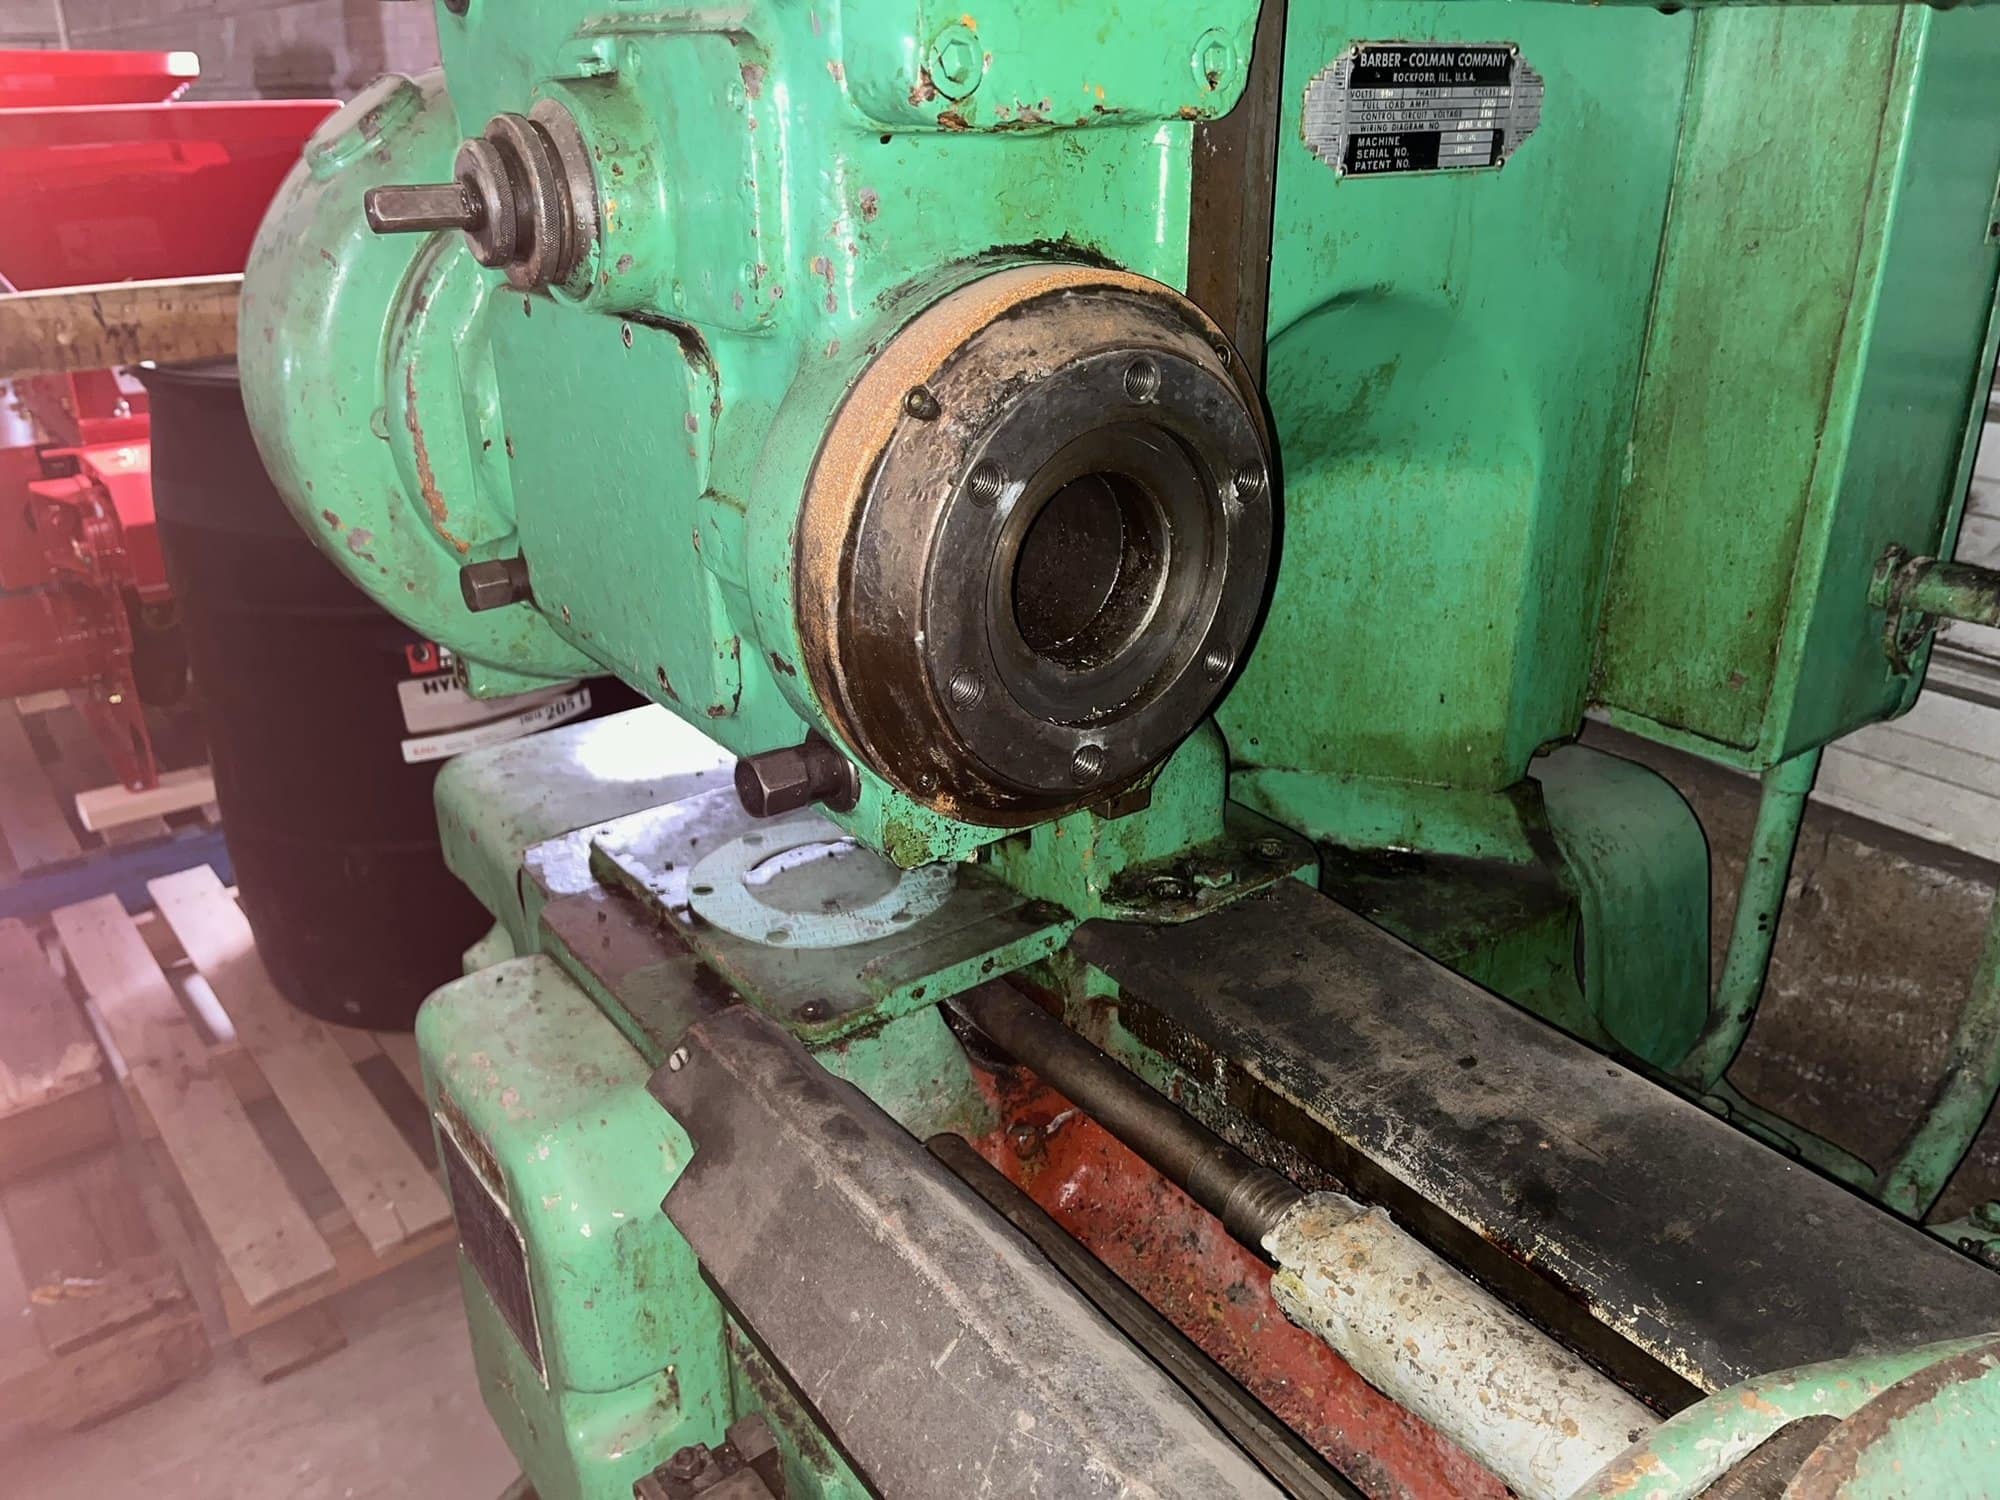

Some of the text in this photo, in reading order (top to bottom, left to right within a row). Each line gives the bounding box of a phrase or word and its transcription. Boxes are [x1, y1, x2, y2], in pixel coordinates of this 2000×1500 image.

[1457, 52, 1508, 67] COMPANY
[1350, 89, 1373, 98] VOLTS
[1415, 88, 1437, 97] PHASE
[1472, 87, 1497, 97] CYCLES
[1362, 101, 1380, 110] FULL
[1384, 101, 1406, 109] LOAD
[1360, 111, 1396, 121] CONTROL
[1400, 111, 1428, 120] CIRCUIT
[1432, 109, 1463, 118] VOLTAGE
[1360, 123, 1388, 132] WIRING
[1391, 122, 1425, 131] DIAGRAM
[1357, 136, 1401, 147] MACHINE
[1356, 146, 1410, 159] SERIAL NO.
[1354, 157, 1411, 172] PATENT NO.
